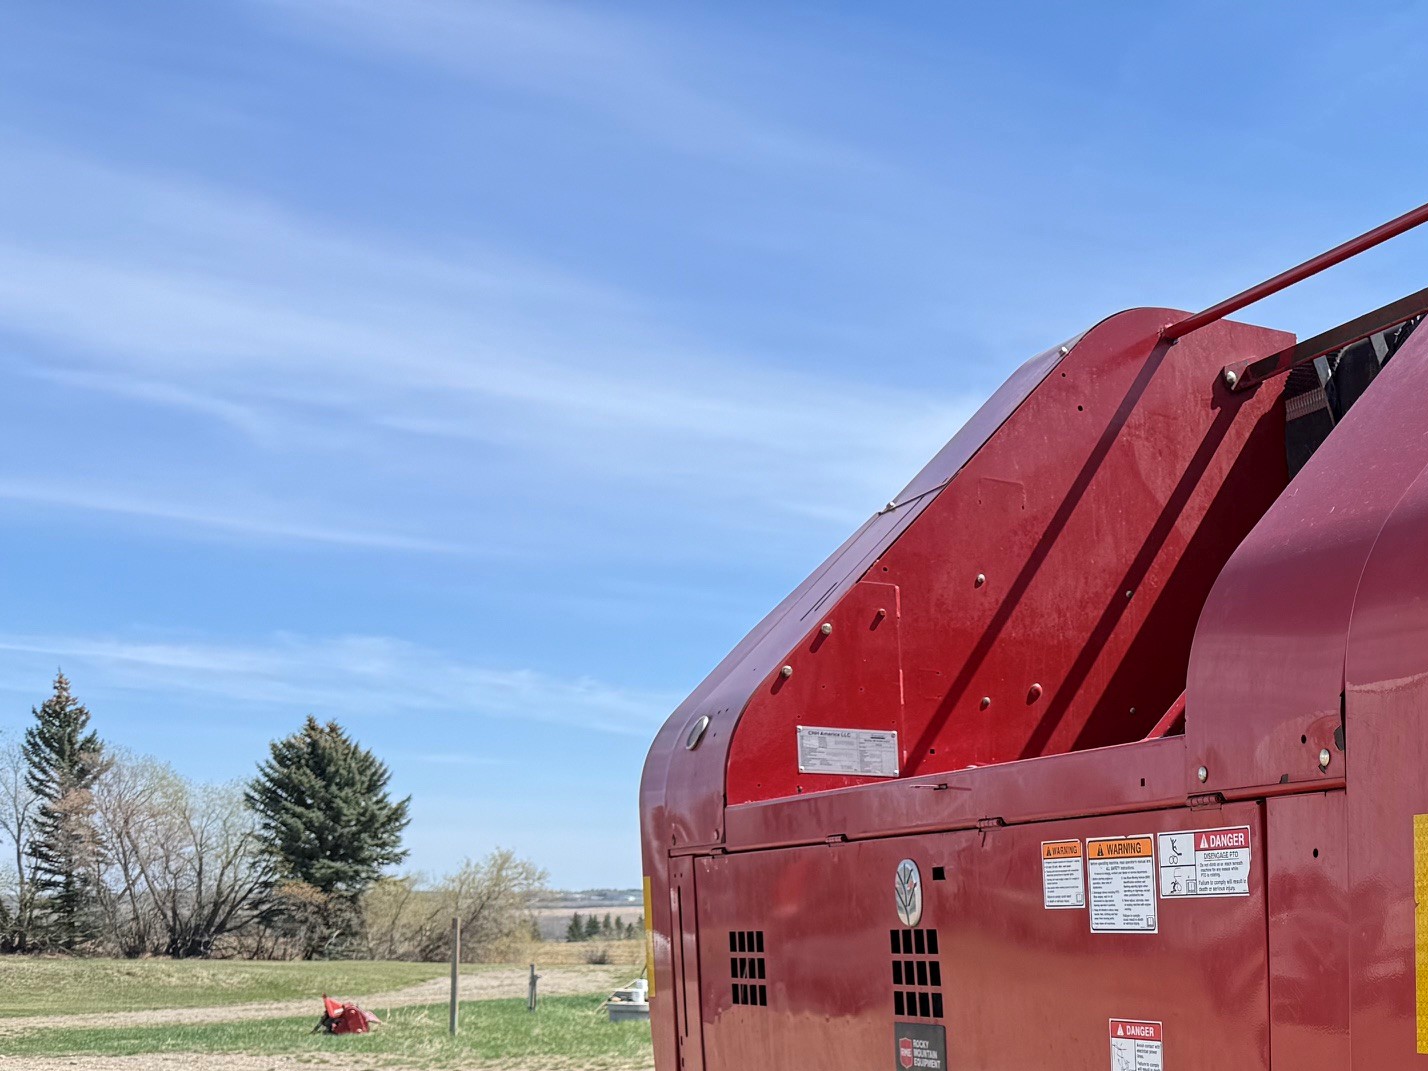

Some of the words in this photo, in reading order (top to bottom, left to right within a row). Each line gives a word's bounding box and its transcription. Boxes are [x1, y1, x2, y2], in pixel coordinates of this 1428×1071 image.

[1209, 833, 1245, 848] DANGER
[1052, 845, 1078, 855] WARNING
[1107, 842, 1142, 855] WARNING
[1126, 1025, 1155, 1037] DANGER
[912, 1039, 929, 1049] ROCKY
